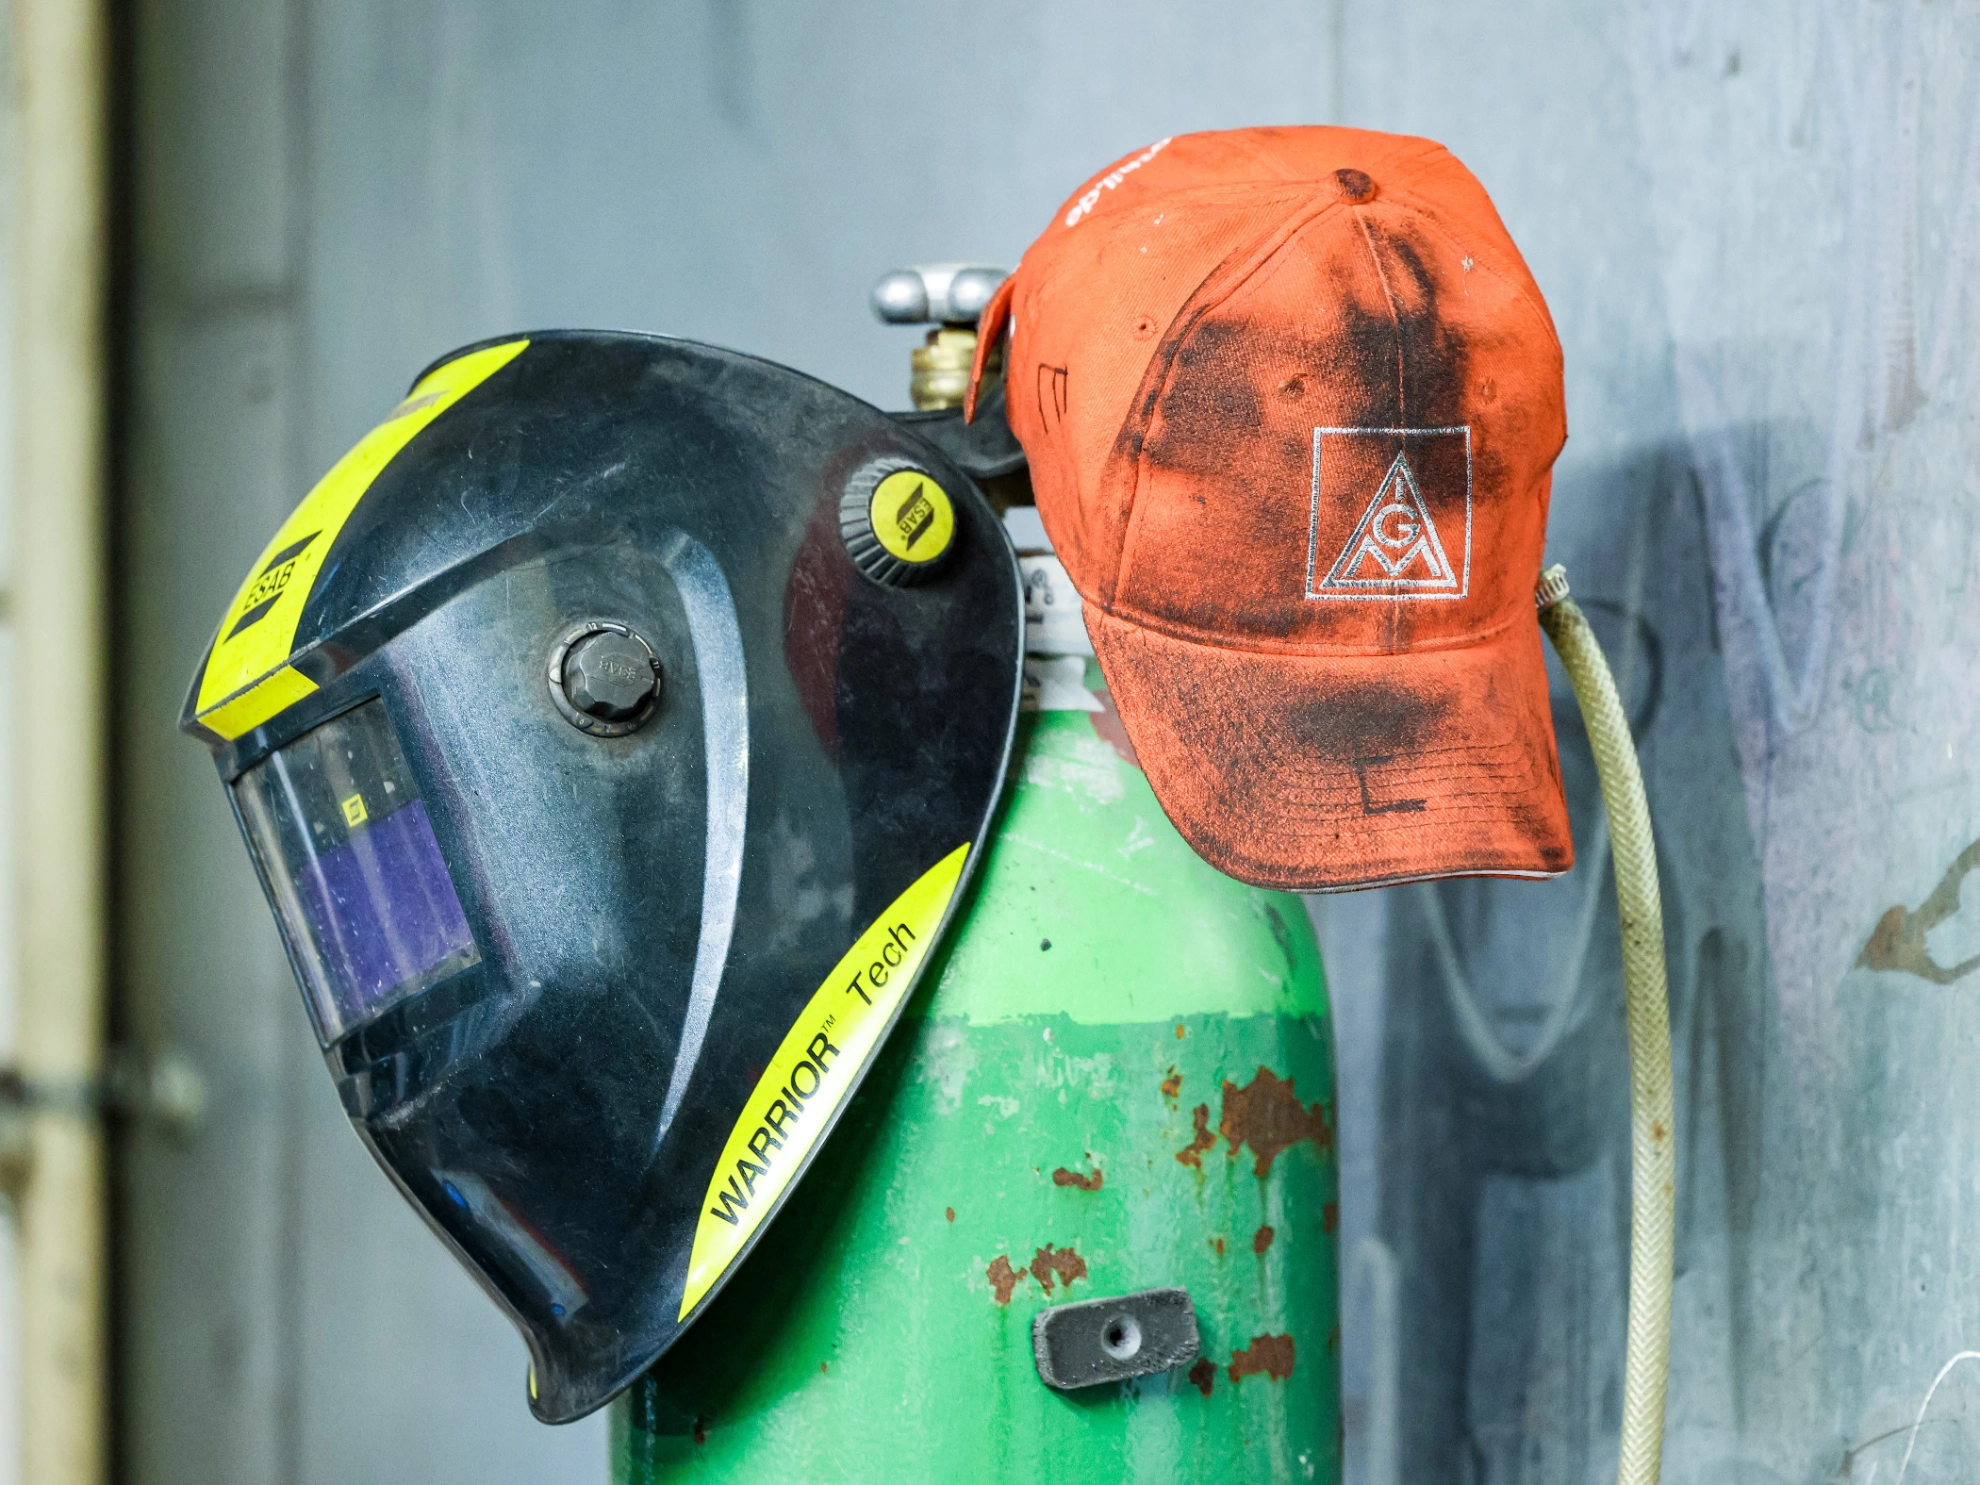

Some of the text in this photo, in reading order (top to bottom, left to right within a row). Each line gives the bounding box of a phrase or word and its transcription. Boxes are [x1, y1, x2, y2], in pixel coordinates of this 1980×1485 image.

[898, 497, 932, 537] ESAB
[243, 560, 296, 611] ESAB
[845, 923, 916, 1006] Tech
